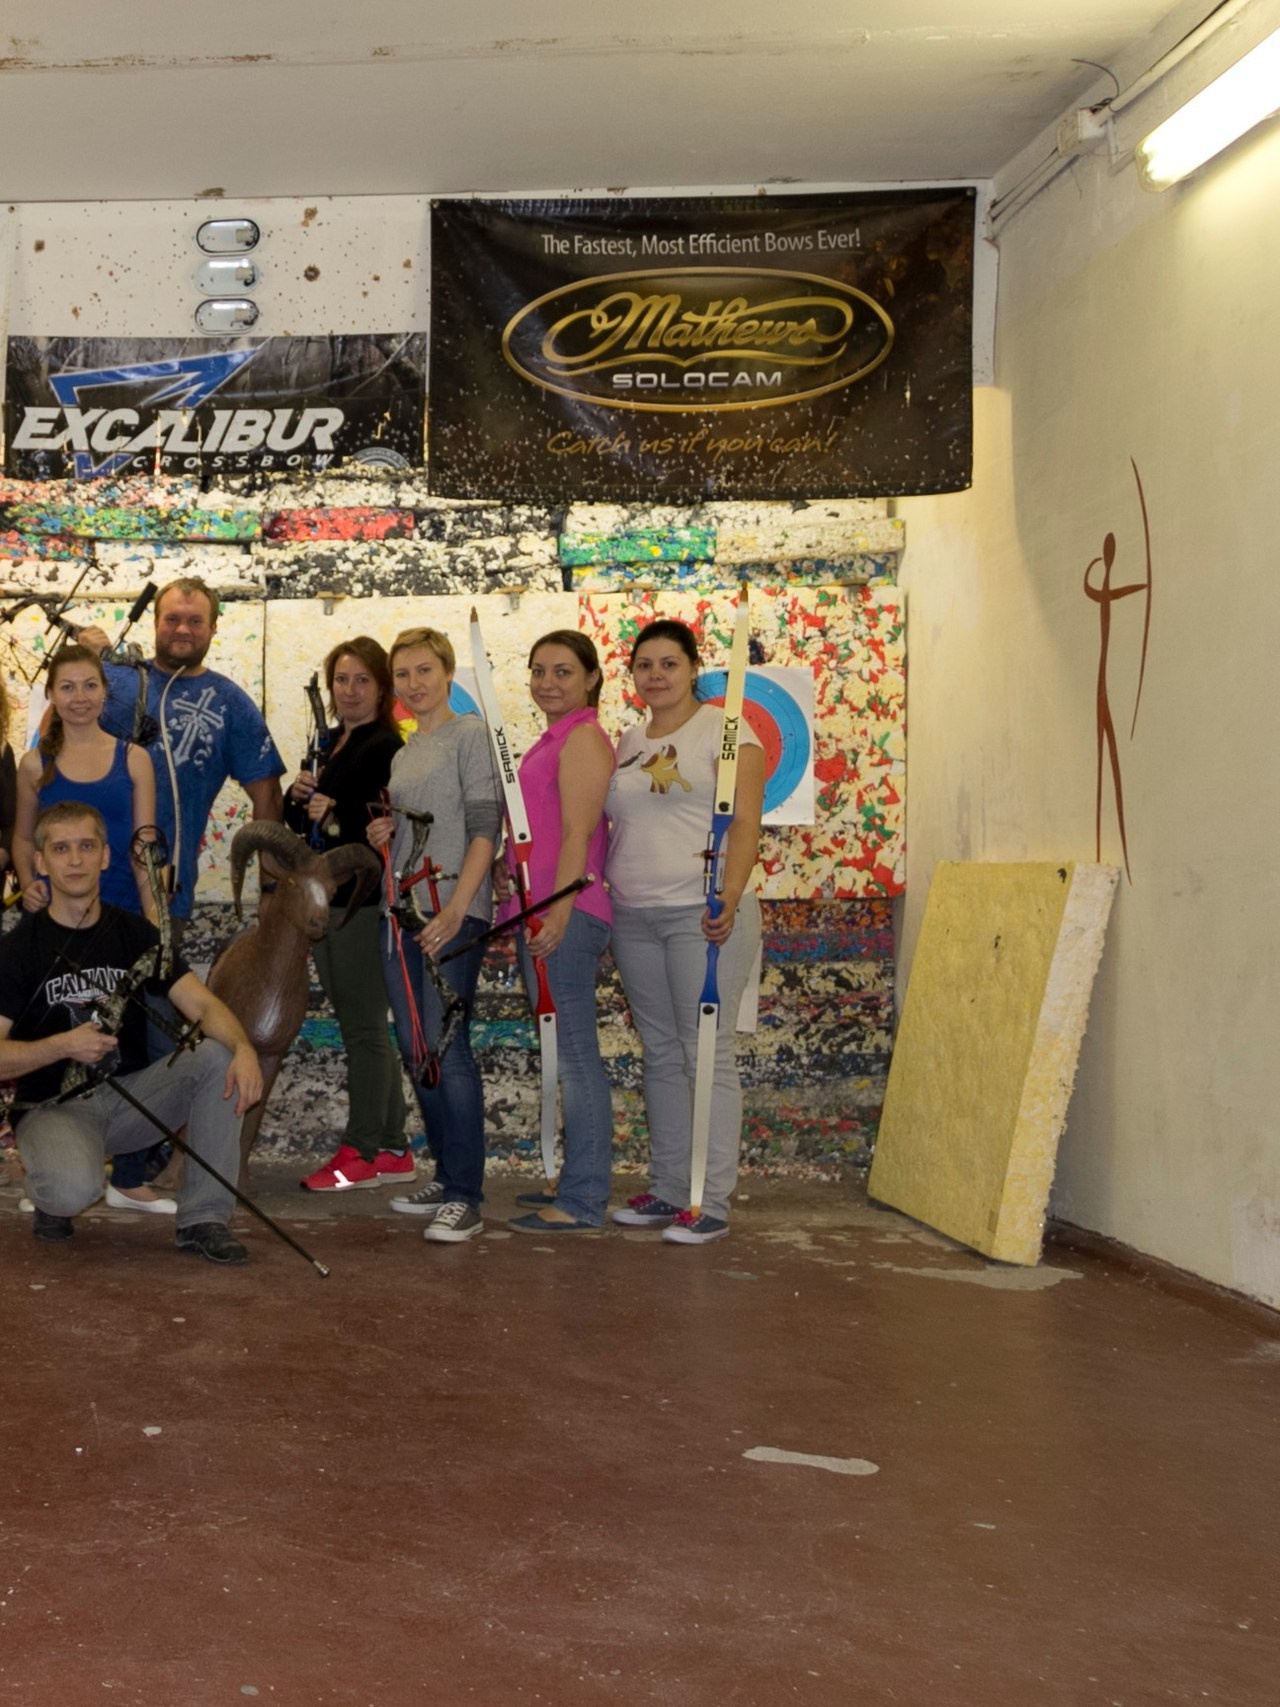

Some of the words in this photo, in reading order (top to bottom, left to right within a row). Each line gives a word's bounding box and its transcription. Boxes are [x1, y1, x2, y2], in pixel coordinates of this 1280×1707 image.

[541, 233, 570, 255] The
[574, 234, 637, 258] Fastest,
[641, 234, 685, 255] Most
[689, 232, 761, 255] Efficient
[764, 231, 814, 252] Bows
[817, 228, 861, 249] Ever!
[542, 291, 853, 366] Mathews
[612, 370, 782, 390] SOLOCAM
[11, 406, 345, 453] EXCALIBUR
[547, 430, 632, 455] Catch
[639, 436, 674, 455] us
[681, 427, 710, 454] if
[706, 435, 764, 463] you
[770, 430, 838, 454] can!
[132, 453, 334, 469] CROSSBOW
[494, 726, 516, 784] SAMICK
[721, 716, 739, 760] SAMICK
